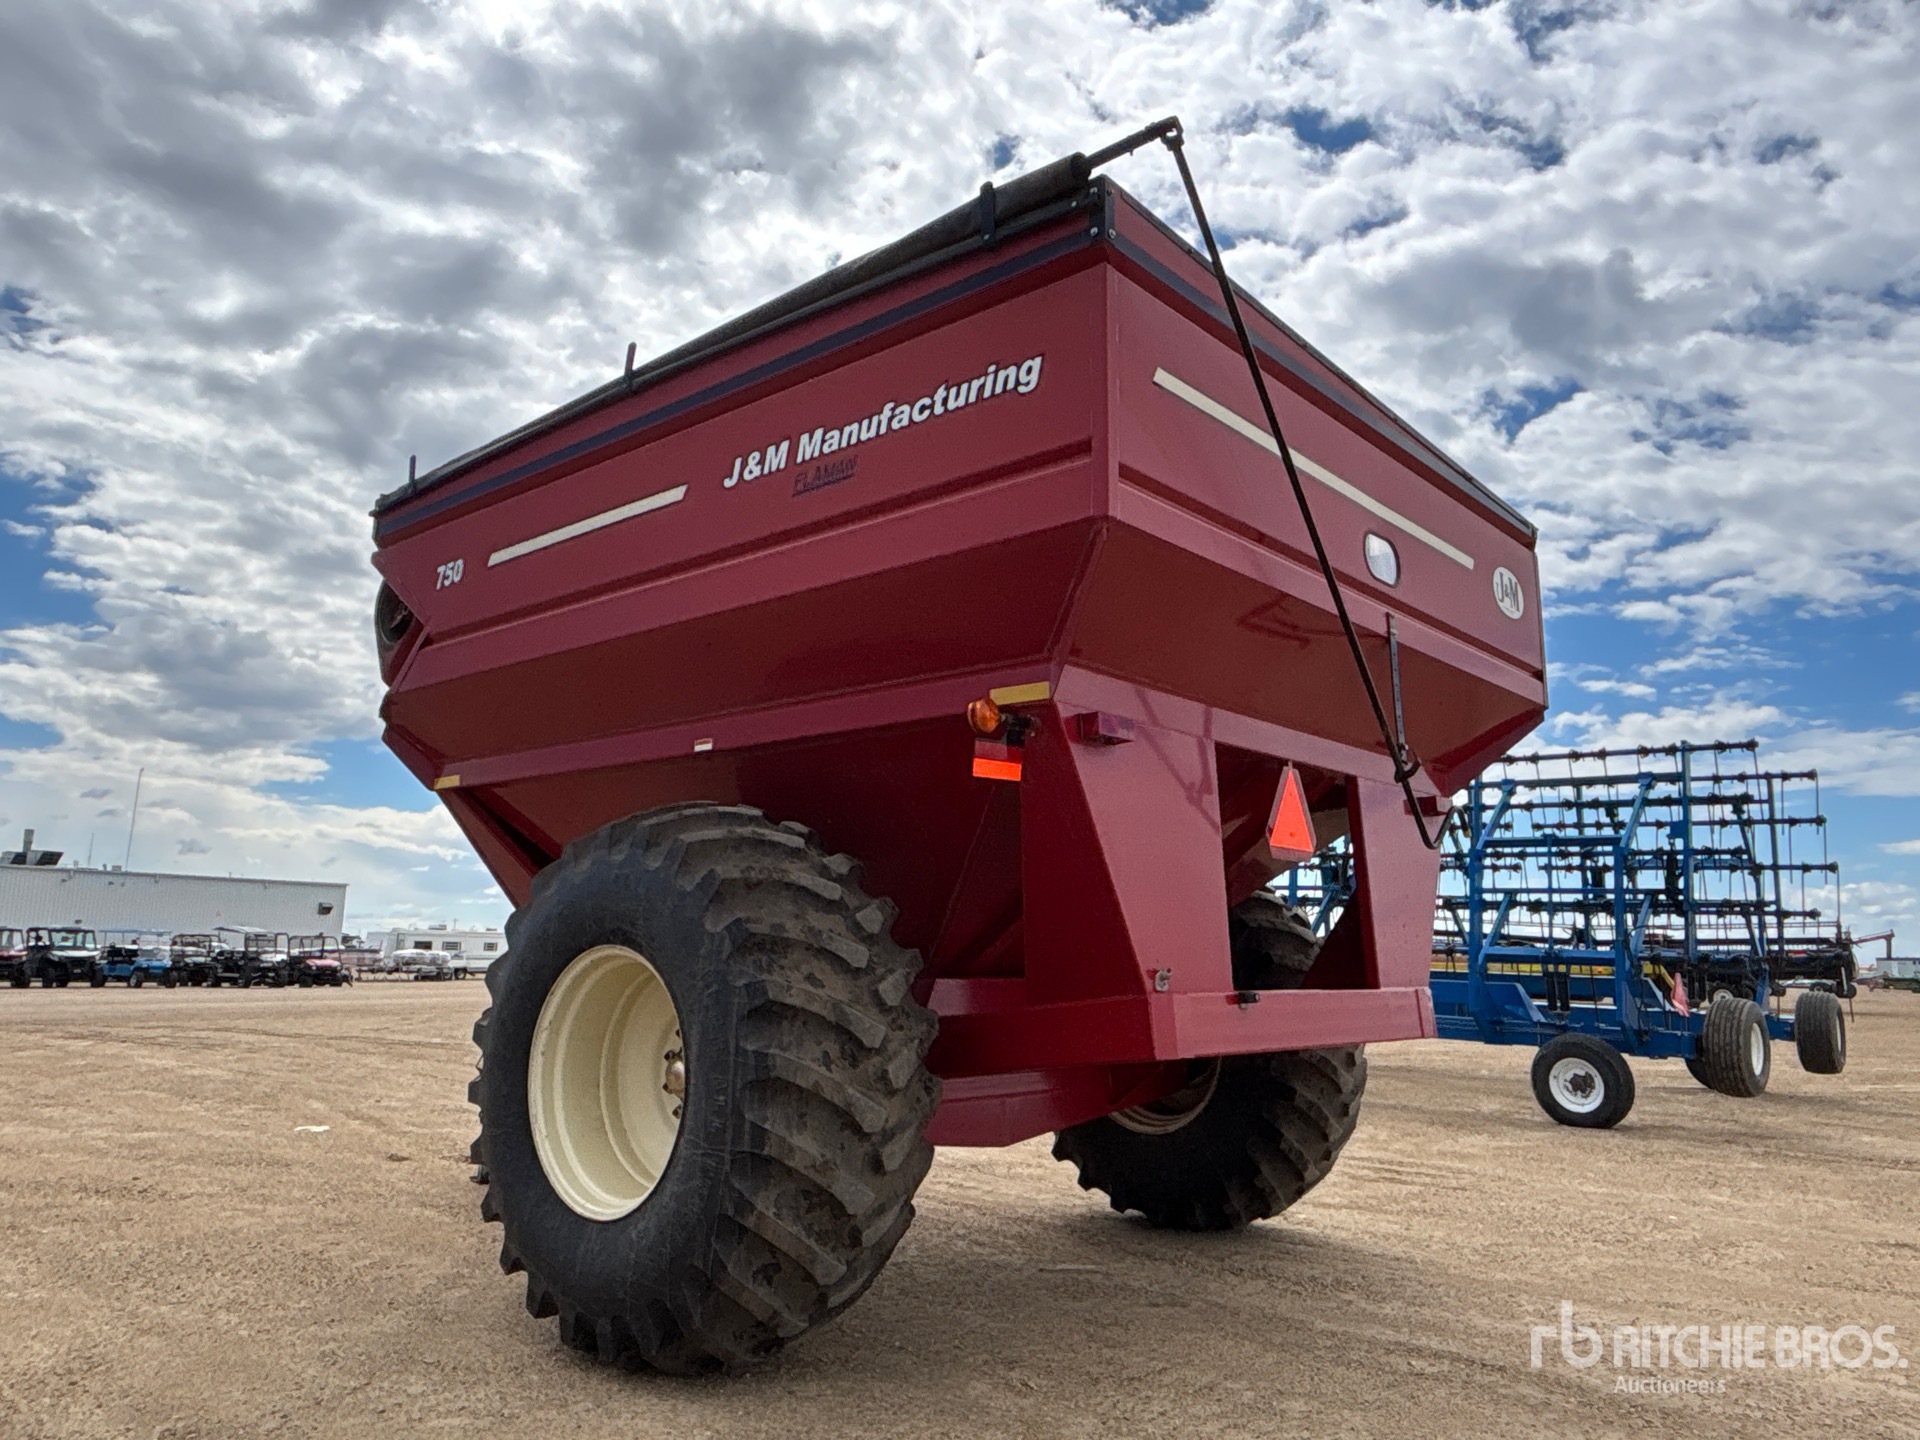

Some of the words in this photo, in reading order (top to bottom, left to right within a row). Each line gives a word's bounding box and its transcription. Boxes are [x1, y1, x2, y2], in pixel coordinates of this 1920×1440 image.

[723, 440, 790, 489] J&M
[796, 354, 1044, 463] Manufacturing
[435, 558, 465, 590] 750
[1495, 570, 1521, 613] J&M
